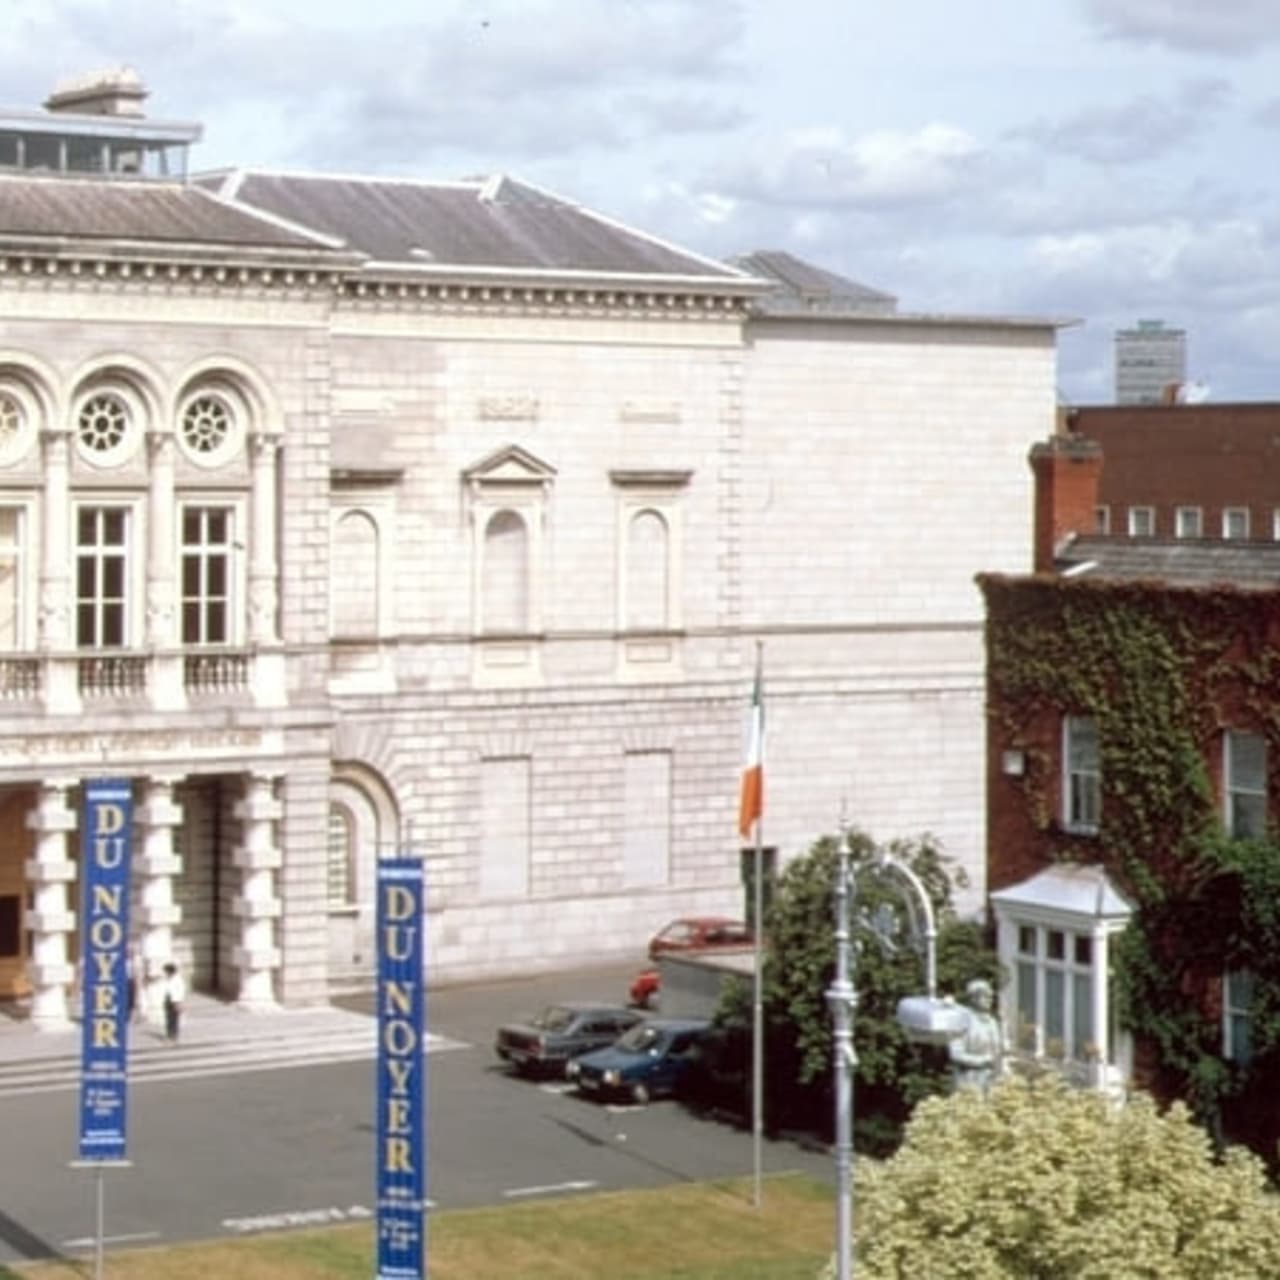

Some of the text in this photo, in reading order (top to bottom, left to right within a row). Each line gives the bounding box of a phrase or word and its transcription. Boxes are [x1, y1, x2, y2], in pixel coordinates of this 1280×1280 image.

[95, 803, 125, 869] DU
[90, 885, 123, 1048] NOYER
[384, 885, 416, 960] DU
[384, 981, 416, 1173] NOYER
